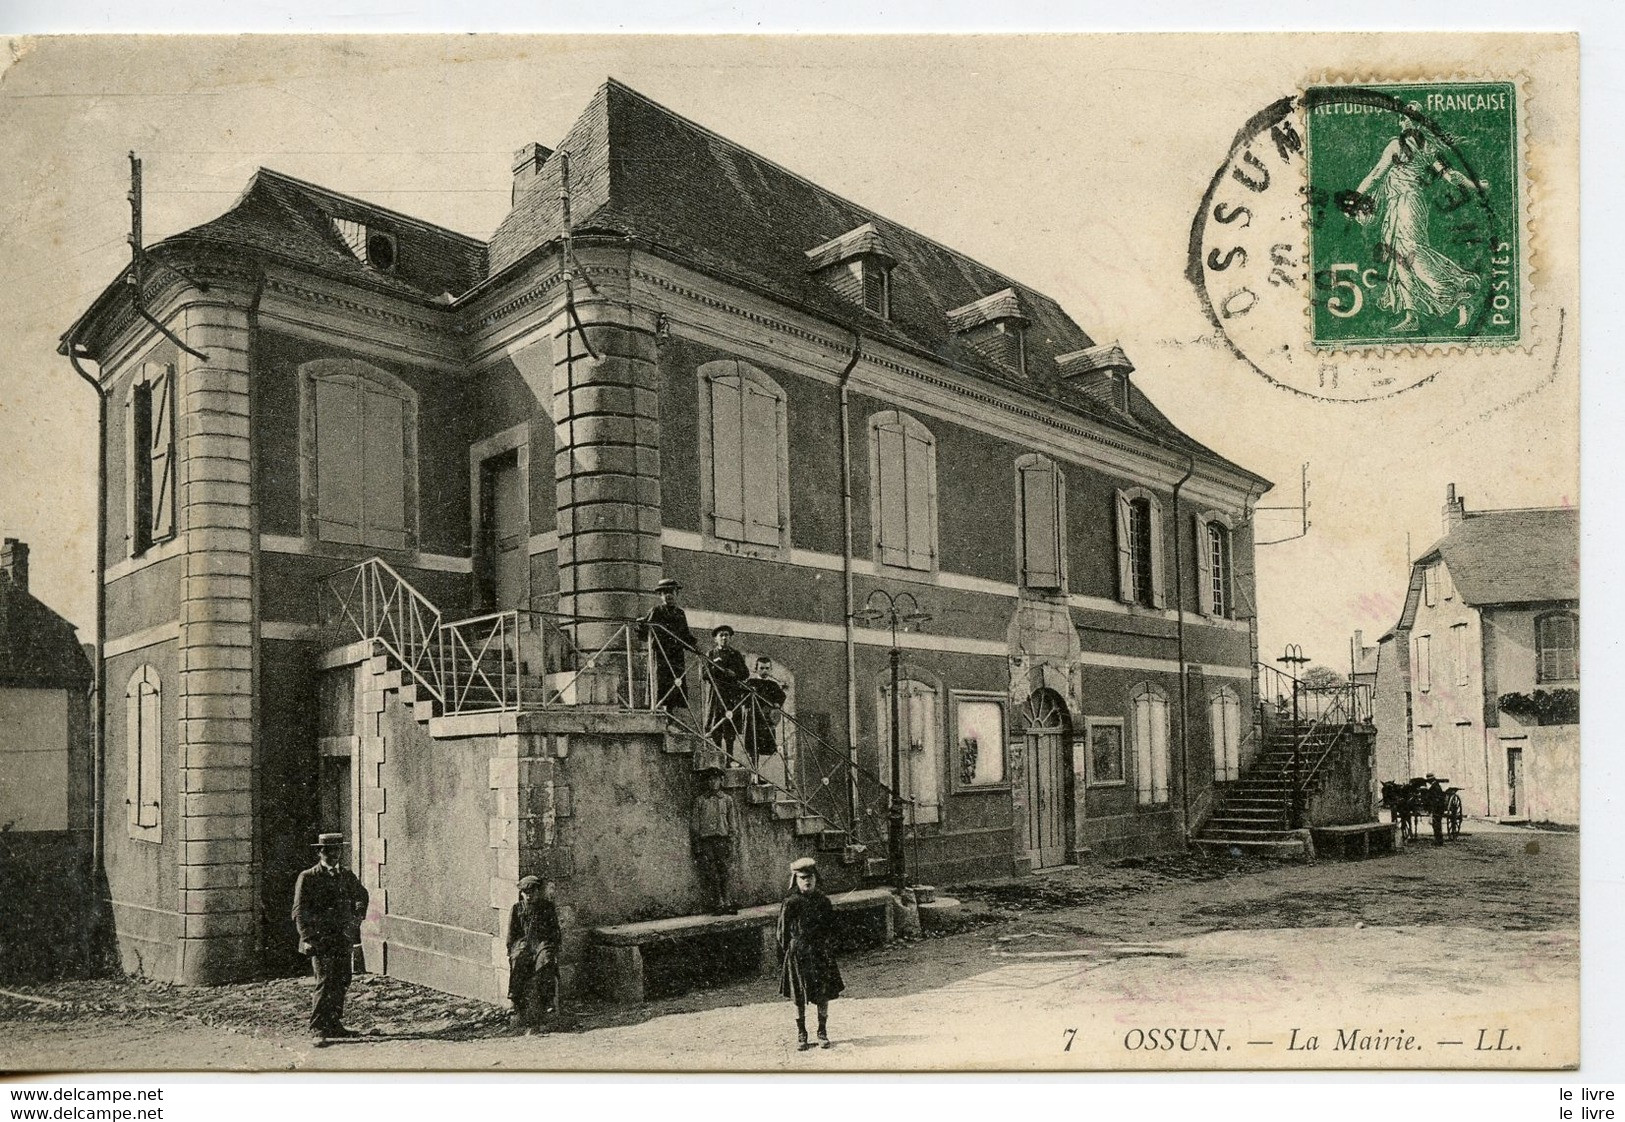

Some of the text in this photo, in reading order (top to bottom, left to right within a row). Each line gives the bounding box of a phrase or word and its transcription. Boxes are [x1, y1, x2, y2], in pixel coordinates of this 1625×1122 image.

[1426, 92, 1507, 113] FRANÇAISE
[1207, 119, 1303, 320] OSSUN
[1491, 242, 1511, 325] POSTES
[1063, 1028, 1079, 1052] 7
[1124, 1028, 1232, 1052] OSSUN.
[1287, 1028, 1320, 1052] La
[1333, 1028, 1423, 1052] Mairie.
